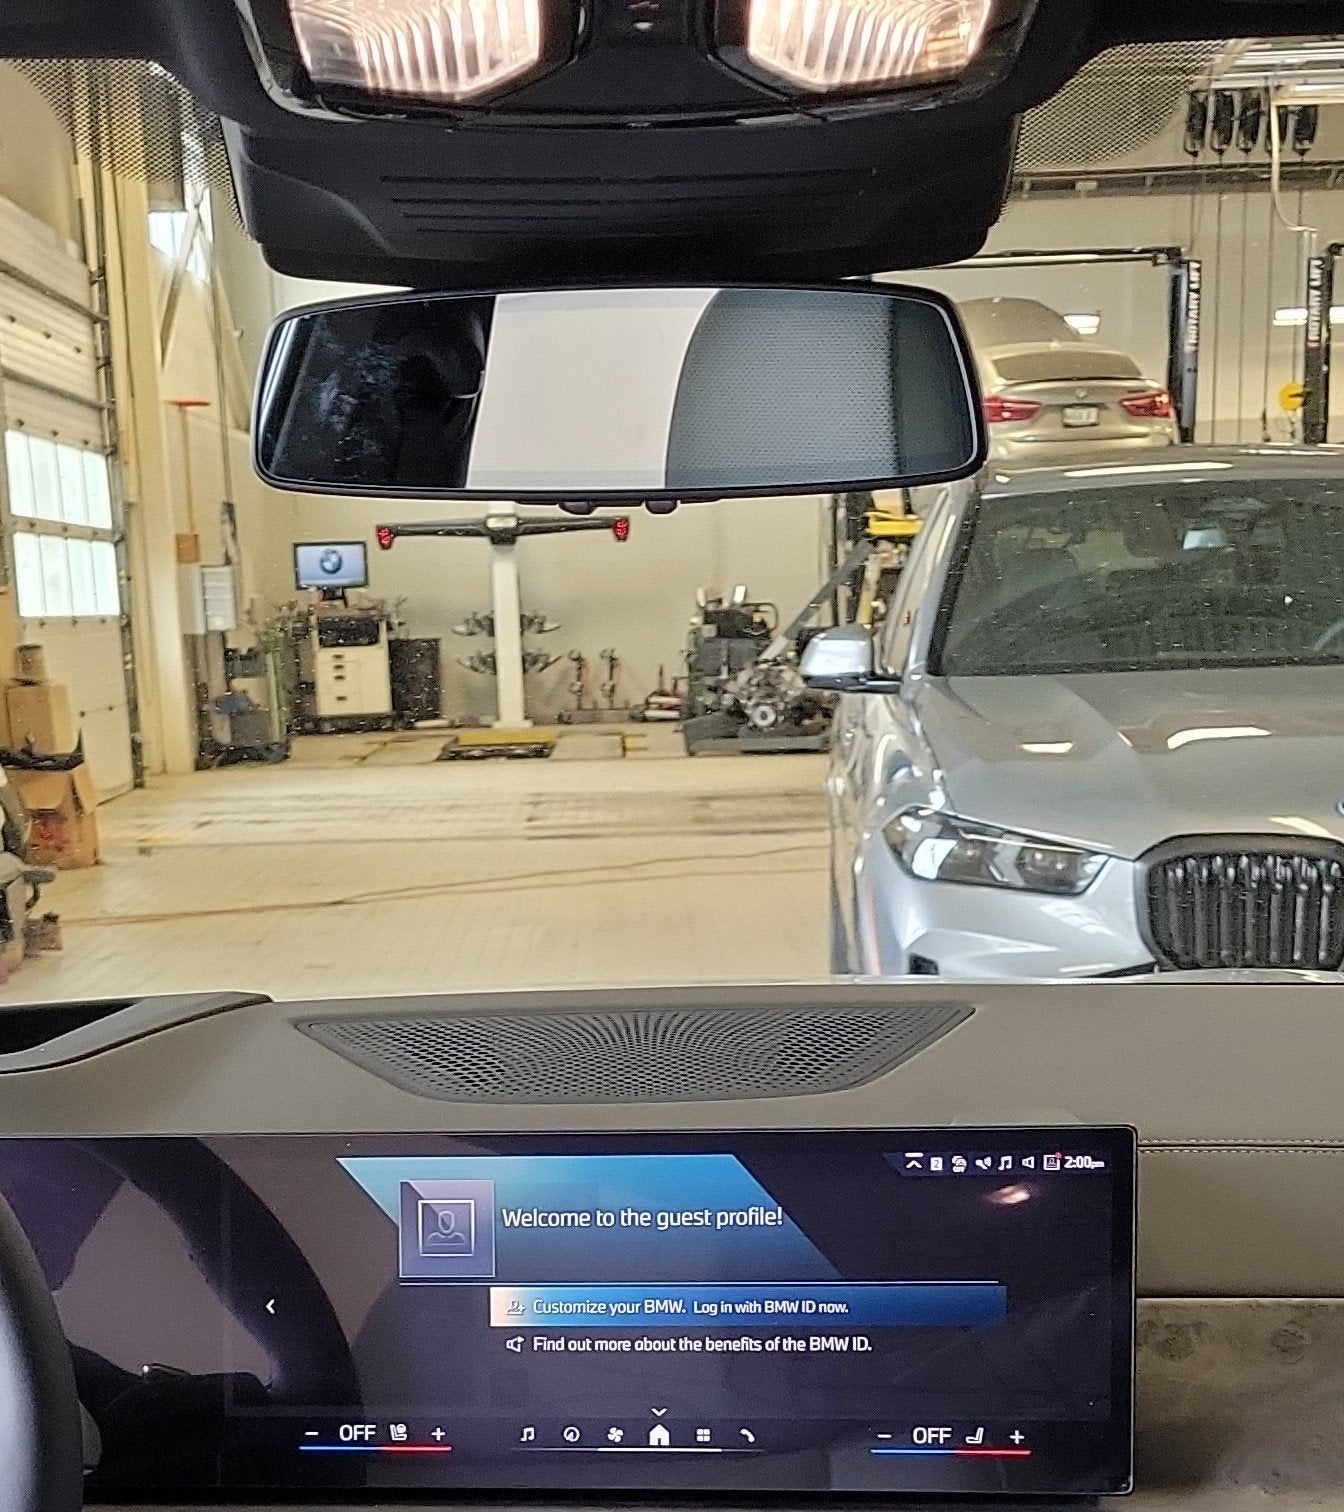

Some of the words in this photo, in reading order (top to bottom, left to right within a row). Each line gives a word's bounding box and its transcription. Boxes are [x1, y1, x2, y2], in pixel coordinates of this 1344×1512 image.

[502, 1207, 590, 1227] Welcome
[596, 1209, 613, 1227] to
[620, 1208, 654, 1226] the
[657, 1209, 713, 1231] guest
[716, 1206, 784, 1230] profile!
[533, 1300, 606, 1315] Customize
[609, 1302, 641, 1317] your
[644, 1300, 687, 1314] BMW.
[693, 1301, 718, 1317] Log
[720, 1301, 733, 1314] in
[734, 1301, 762, 1314] with
[764, 1301, 799, 1314] BMW
[801, 1301, 816, 1314] ID
[818, 1302, 849, 1314] now.
[533, 1337, 565, 1352] Find
[568, 1338, 593, 1352] out
[594, 1340, 632, 1352] more
[634, 1337, 676, 1352] about
[678, 1337, 703, 1351] the
[705, 1337, 763, 1352] benefits
[765, 1337, 780, 1352] of
[782, 1337, 807, 1352] the
[809, 1337, 849, 1351] BMW
[852, 1337, 873, 1351] ID.
[339, 1424, 377, 1441] OFF
[913, 1427, 952, 1444] OFF
